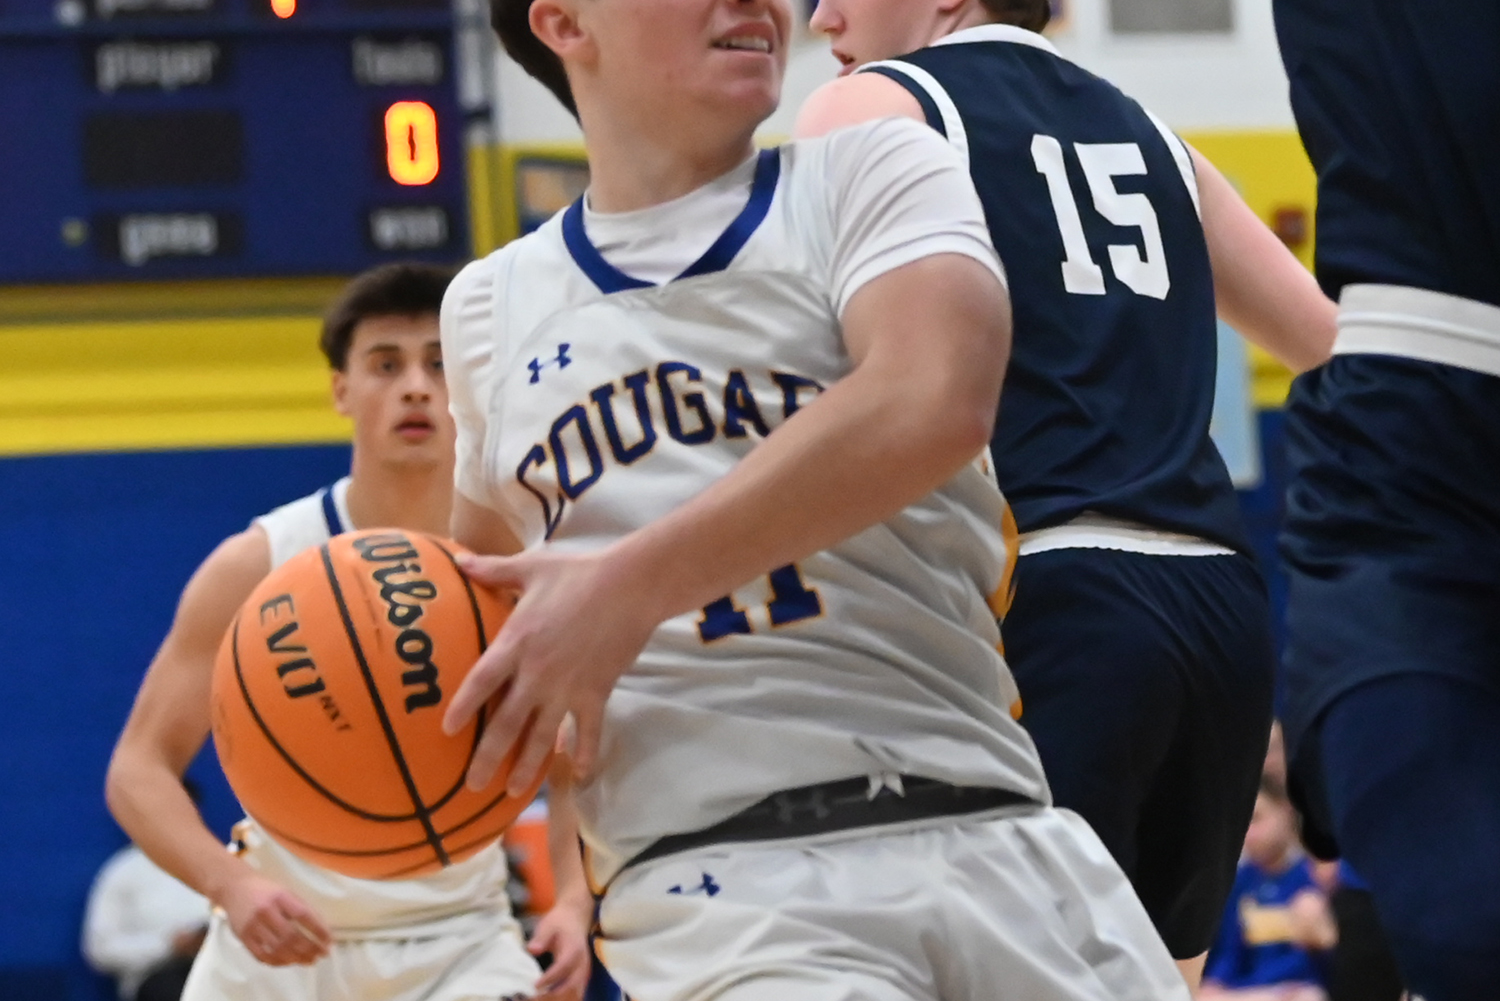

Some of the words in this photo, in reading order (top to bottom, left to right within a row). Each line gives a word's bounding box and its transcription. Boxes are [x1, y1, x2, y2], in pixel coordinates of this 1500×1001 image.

[384, 101, 440, 186] 0
[1030, 133, 1171, 301] 15
[351, 533, 443, 715] Wilson
